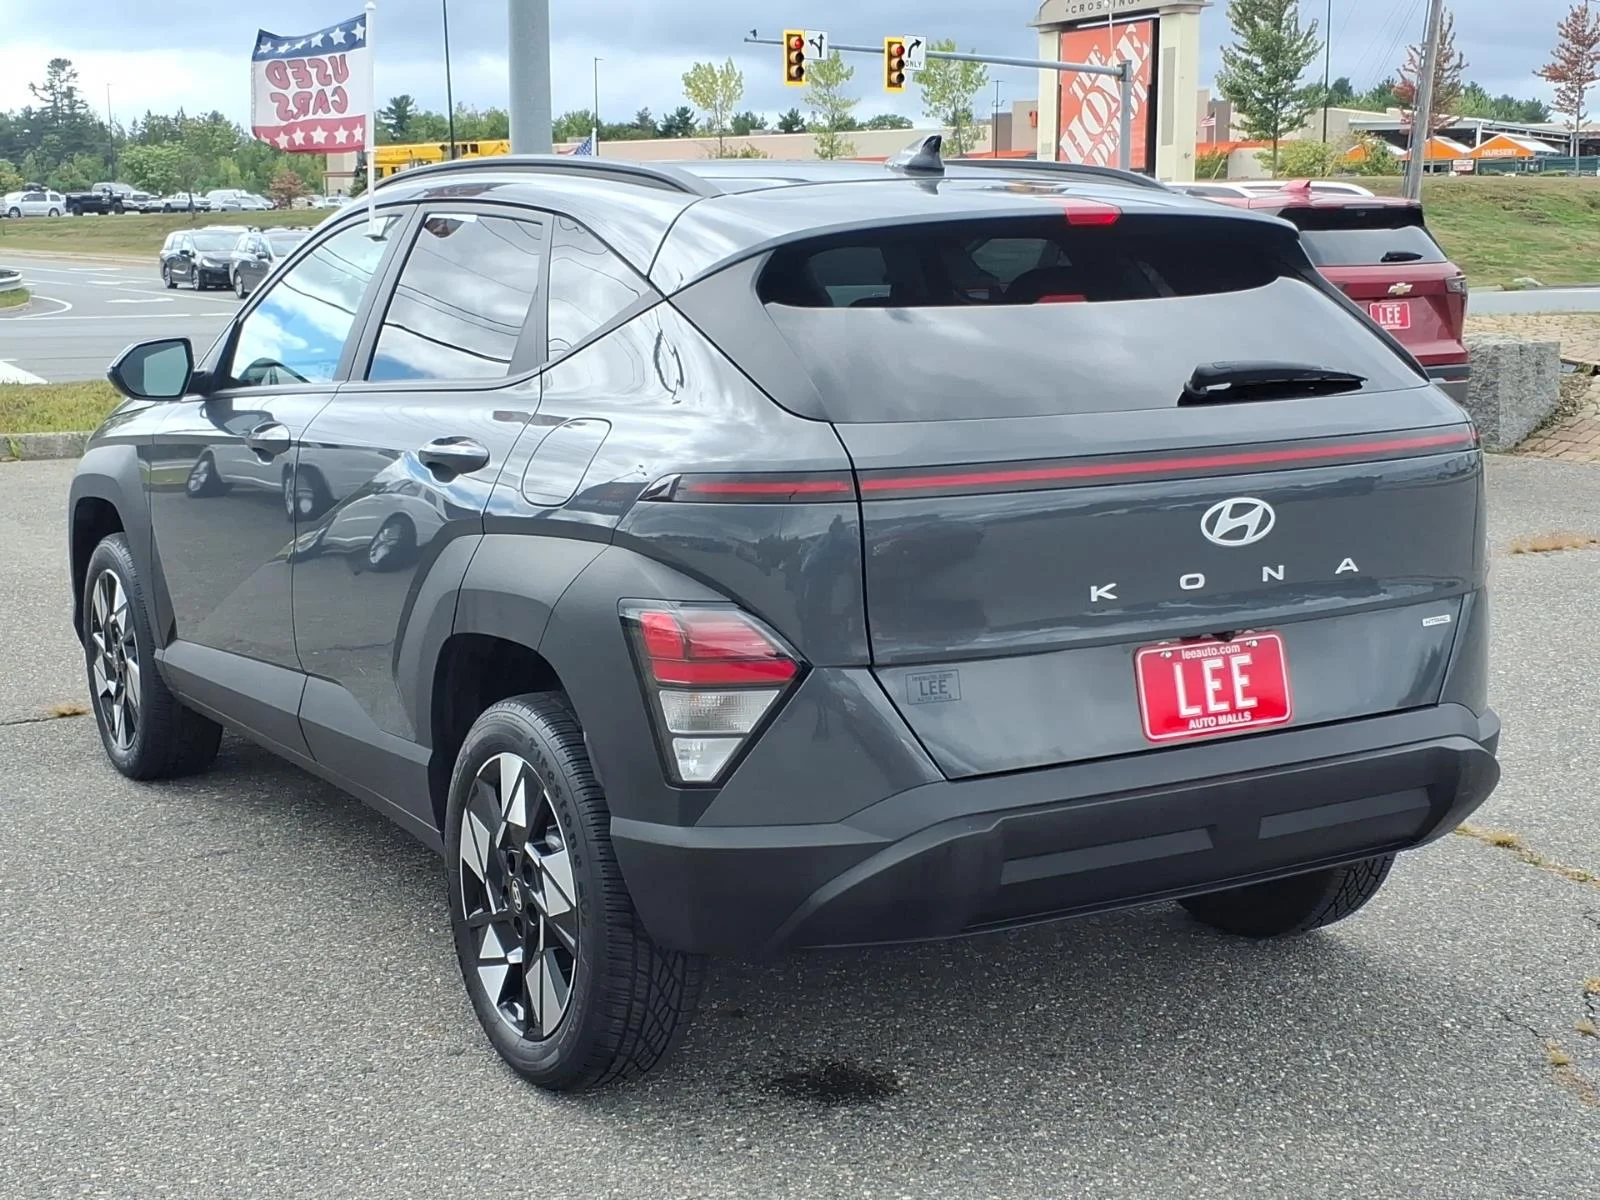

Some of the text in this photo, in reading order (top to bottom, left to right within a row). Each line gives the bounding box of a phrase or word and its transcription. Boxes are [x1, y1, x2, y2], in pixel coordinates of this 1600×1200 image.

[905, 60, 922, 68] ONLY
[1069, 44, 1106, 102] THE
[1060, 24, 1149, 164] HOME
[1481, 148, 1518, 157] NURSERY
[1379, 307, 1402, 324] LEE
[1090, 557, 1359, 602] KONA
[1181, 644, 1241, 660] leeauto.com
[920, 679, 948, 696] LEE
[1173, 653, 1258, 718] LEE
[1188, 712, 1251, 730] AUTO MALLS
